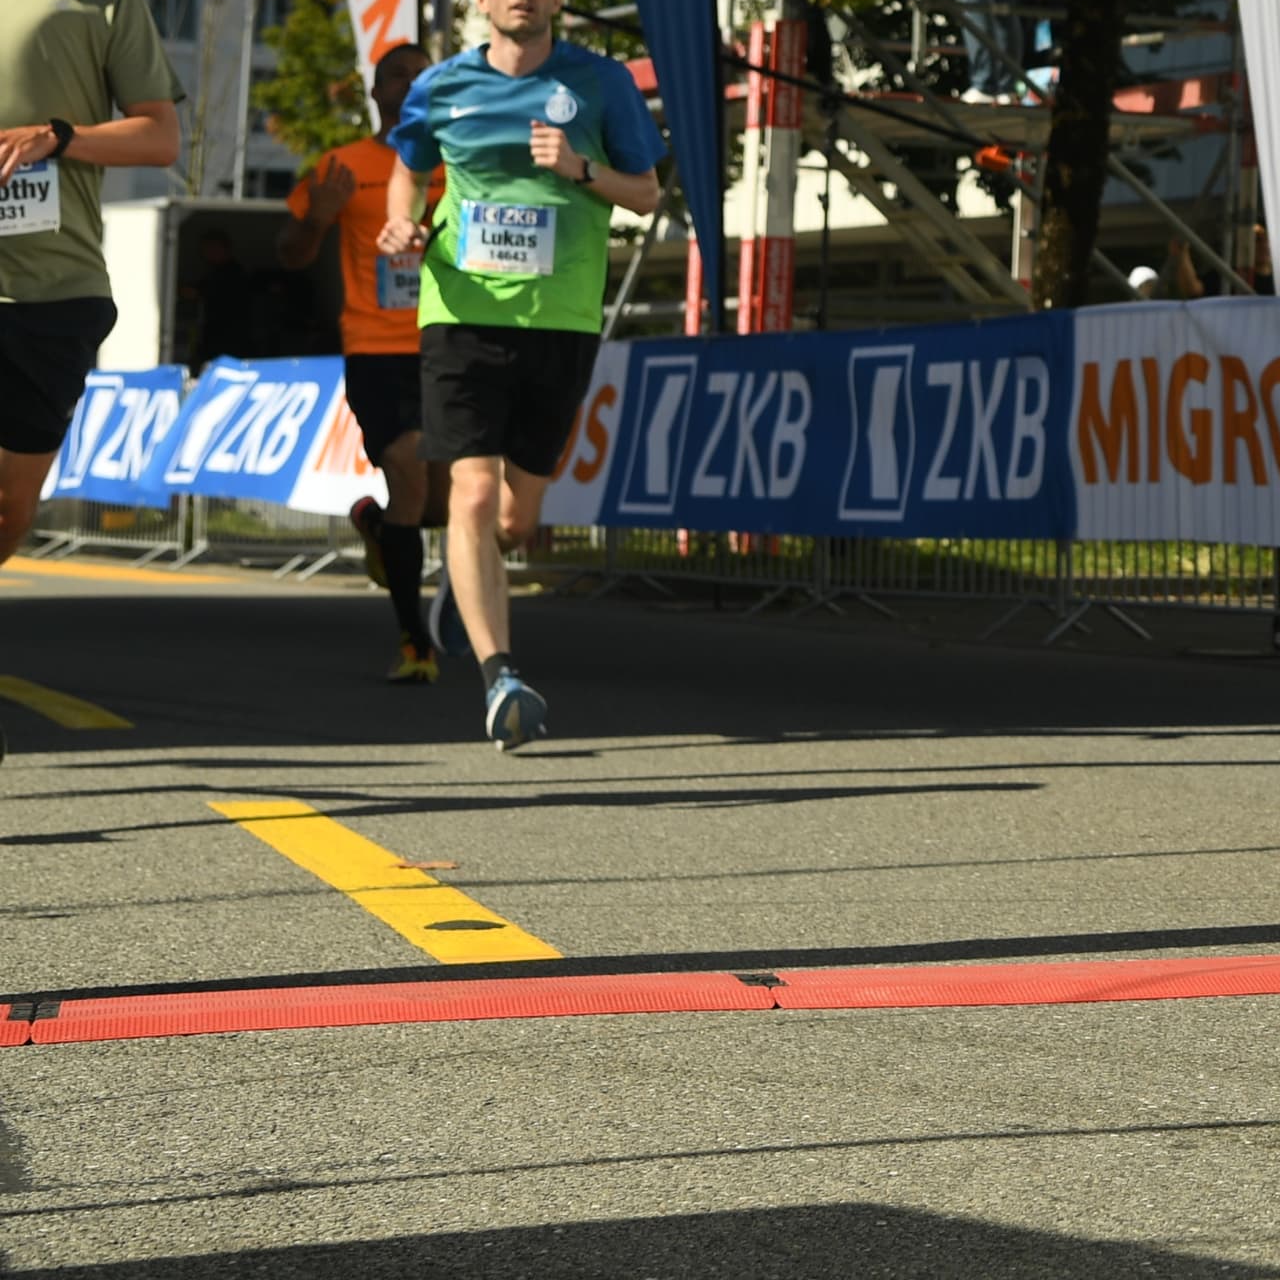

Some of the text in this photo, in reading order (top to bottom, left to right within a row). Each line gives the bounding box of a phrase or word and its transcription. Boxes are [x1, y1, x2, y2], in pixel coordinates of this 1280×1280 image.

[481, 228, 538, 249] Lukas
[502, 208, 538, 224] ZKB
[204, 381, 320, 476] ZKB
[690, 370, 813, 500] ZKB
[922, 356, 1051, 502] ZKB
